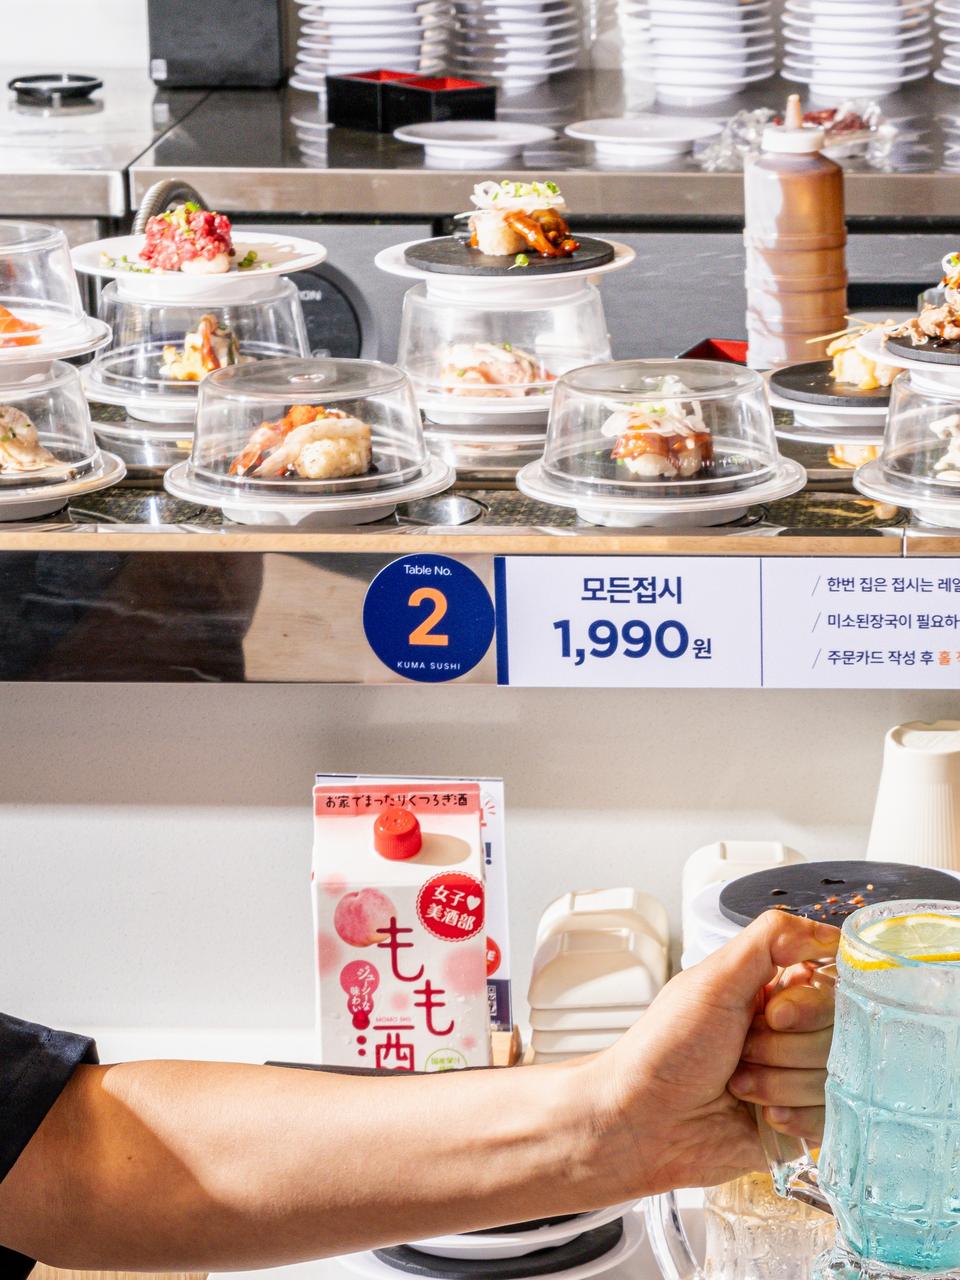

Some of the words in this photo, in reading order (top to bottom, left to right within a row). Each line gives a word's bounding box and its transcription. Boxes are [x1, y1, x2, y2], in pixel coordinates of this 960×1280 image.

[403, 564, 431, 575] Table
[434, 564, 453, 576] No.
[581, 576, 683, 605] 모든접시
[827, 577, 855, 594] 한번
[859, 577, 888, 594] 집은
[891, 577, 934, 594] 접시는
[407, 587, 449, 646] 2
[827, 613, 912, 630] 미소된장국이
[397, 661, 426, 670] KUMA
[430, 662, 460, 671] SUSHI
[827, 650, 884, 666] 주문카드
[888, 650, 915, 666] 작성
[920, 650, 934, 666] 후
[938, 650, 951, 666] 홀
[325, 793, 468, 809] お家でまったりくつろぎ酒
[432, 885, 465, 906] 女子
[425, 903, 476, 931] 美酒部
